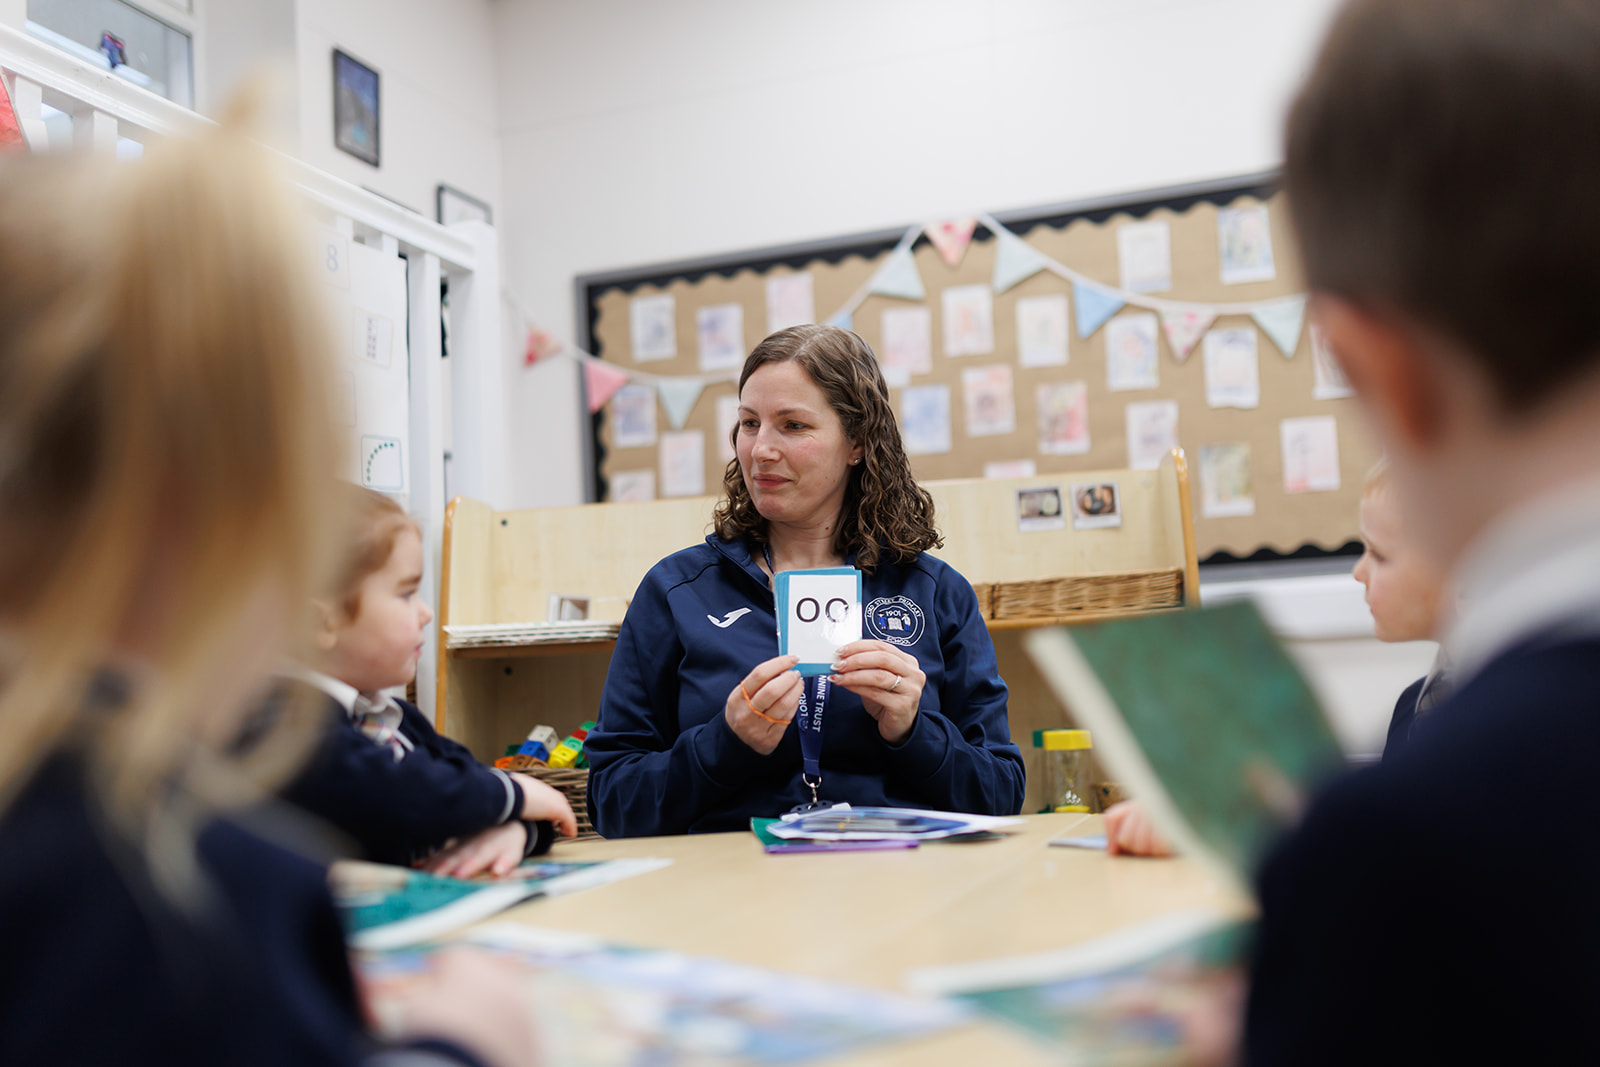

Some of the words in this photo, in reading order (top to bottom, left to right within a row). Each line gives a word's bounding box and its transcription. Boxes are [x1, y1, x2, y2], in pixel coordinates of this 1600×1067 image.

[816, 674, 828, 700] NNINE
[798, 692, 809, 717] LORD
[812, 701, 825, 733] TRUST
